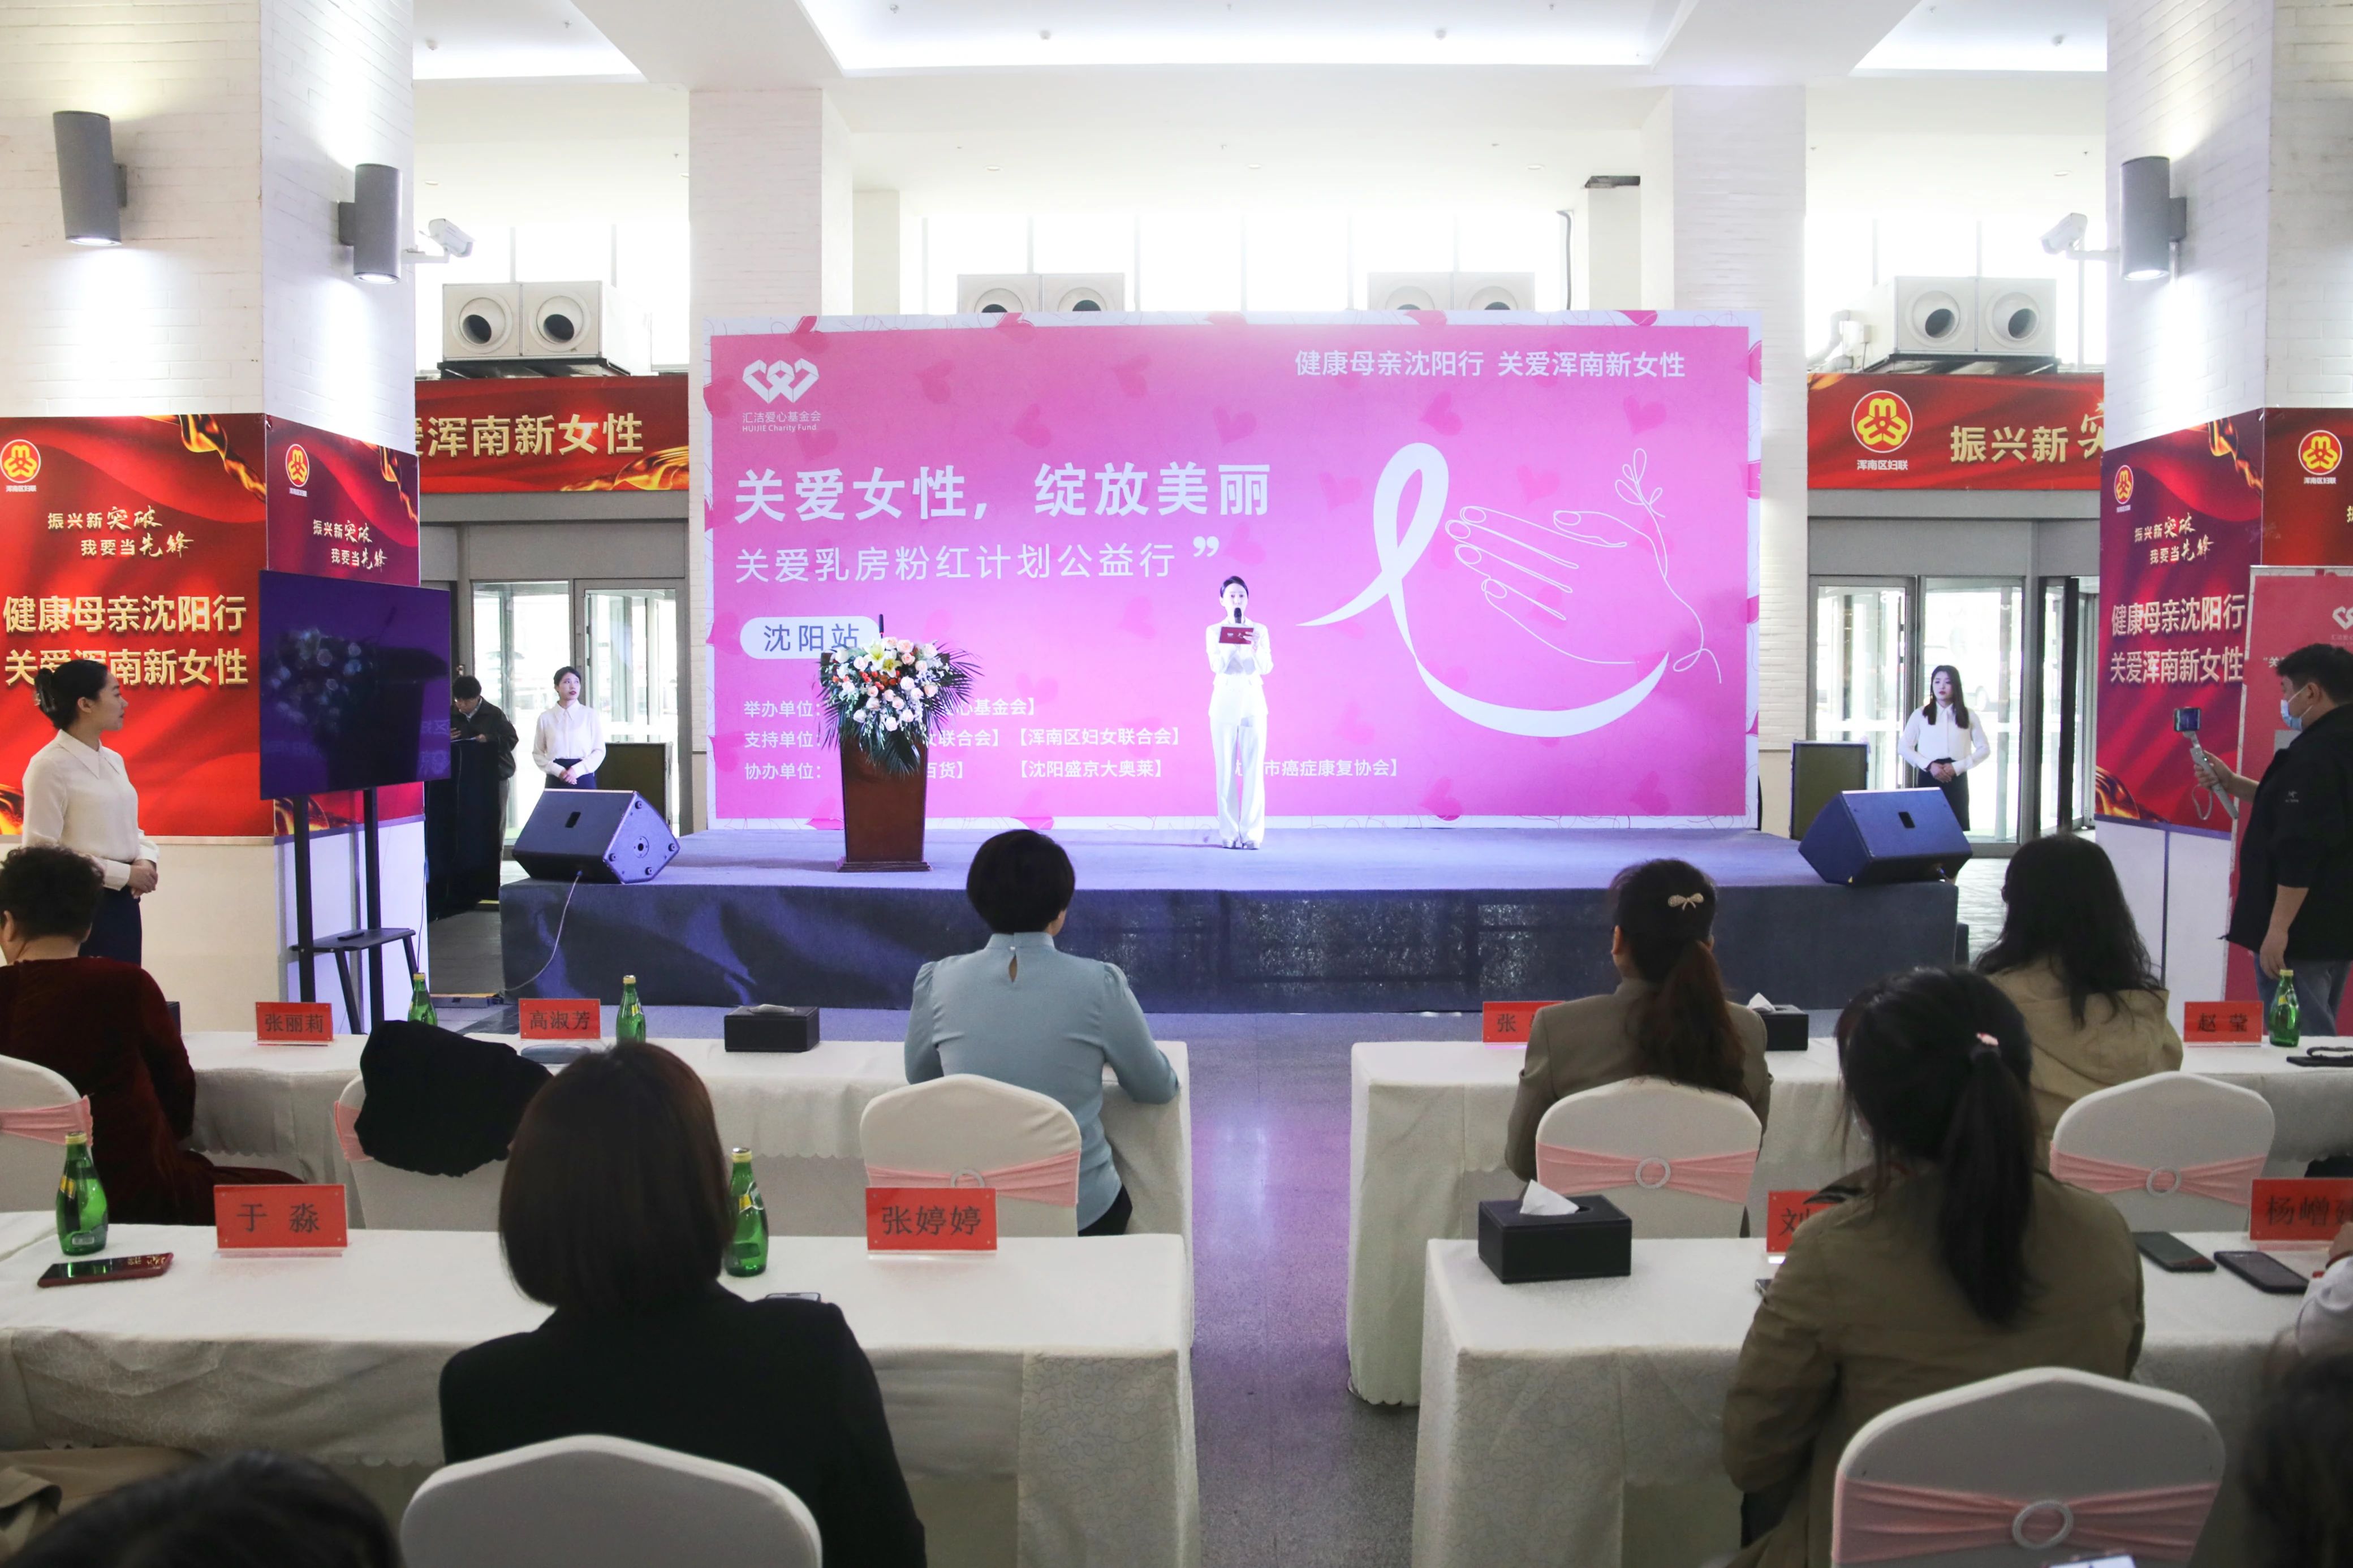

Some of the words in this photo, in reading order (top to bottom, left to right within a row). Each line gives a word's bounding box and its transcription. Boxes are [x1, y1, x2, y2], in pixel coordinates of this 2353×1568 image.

[1295, 349, 1484, 378] 健康母亲沈阳行
[1498, 350, 1685, 378] 关爱浑南新女性
[742, 411, 821, 424] 汇洁爱心基金会
[768, 424, 796, 433] Charity
[416, 412, 644, 458] 浑南新女性
[1857, 459, 1908, 471] 浑南区妇联
[48, 505, 163, 530] 振兴新突破
[313, 519, 373, 543] 振兴新突破
[81, 530, 194, 559] 我要当先锋
[2, 595, 248, 634] 健康母亲沈阳行
[2111, 594, 2246, 637] 健康母亲沈阳行
[764, 623, 859, 653] 沈阳站
[2110, 646, 2244, 684] 关爱浑南新女性
[1020, 727, 1179, 746] 【浑南区妇女联合会】
[1020, 760, 1162, 779] 【沈阳盛京大奥莱】
[264, 1013, 324, 1034] 张丽莉
[529, 1009, 591, 1031] 高淑芳
[881, 1205, 982, 1236] 张婷婷
